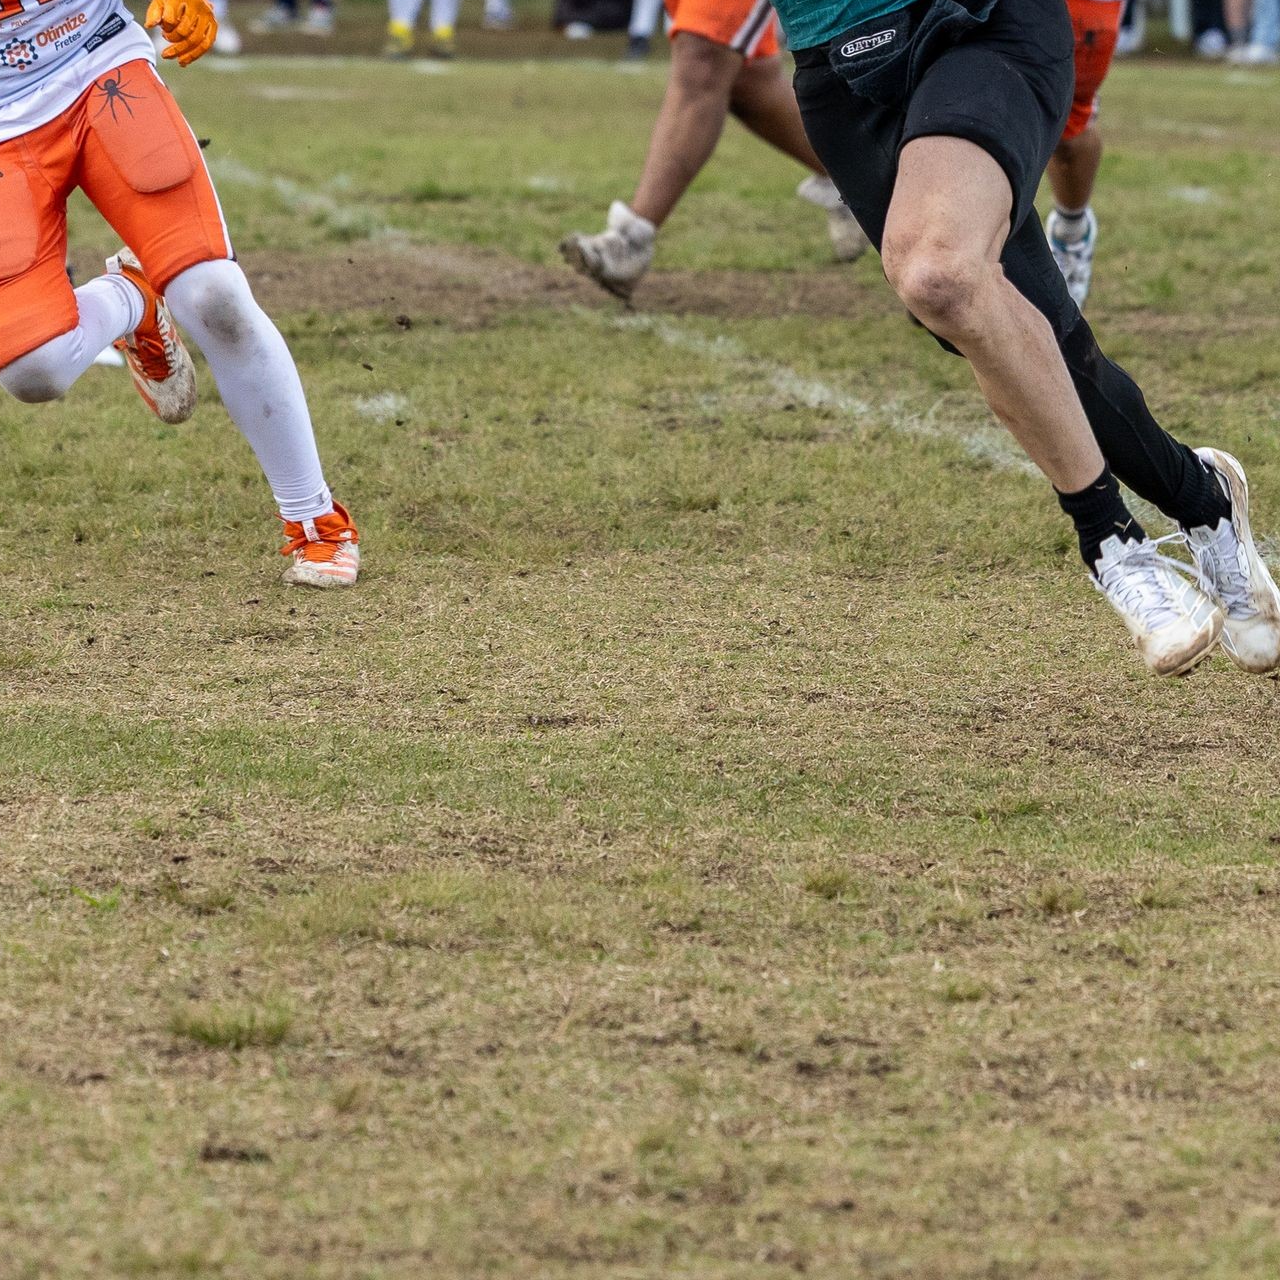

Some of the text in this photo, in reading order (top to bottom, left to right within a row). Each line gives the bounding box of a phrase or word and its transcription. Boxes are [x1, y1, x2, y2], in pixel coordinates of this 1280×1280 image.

[35, 11, 88, 48] Otimize
[54, 30, 82, 51] Fretes
[845, 32, 893, 55] BATTLE
